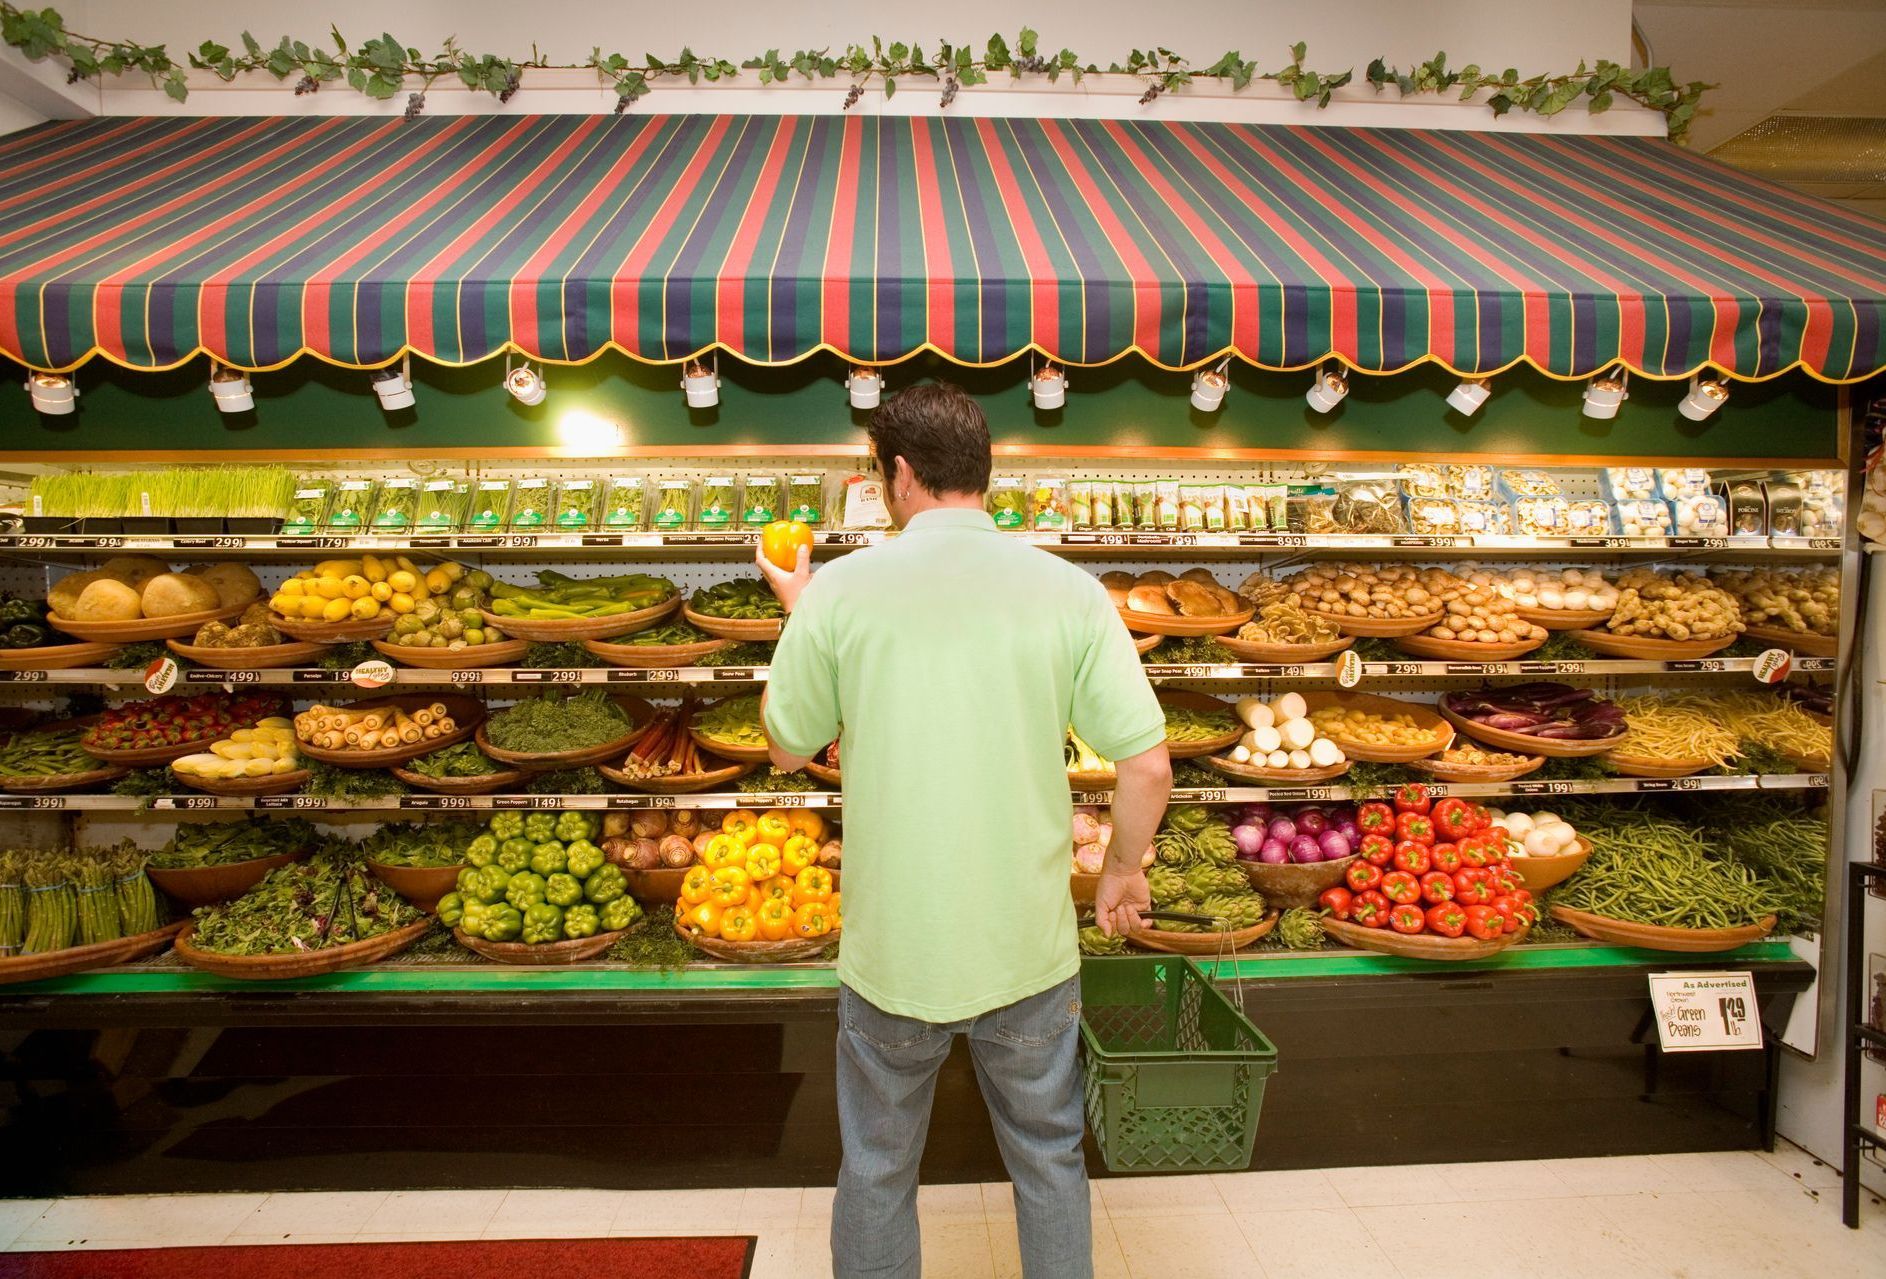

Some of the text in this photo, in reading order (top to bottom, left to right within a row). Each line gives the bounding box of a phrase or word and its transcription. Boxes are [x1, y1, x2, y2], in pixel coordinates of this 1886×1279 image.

[1683, 980, 1747, 989] As Advertised
[1677, 1006, 1706, 1021] Green
[1668, 1021, 1701, 1037] Beans
